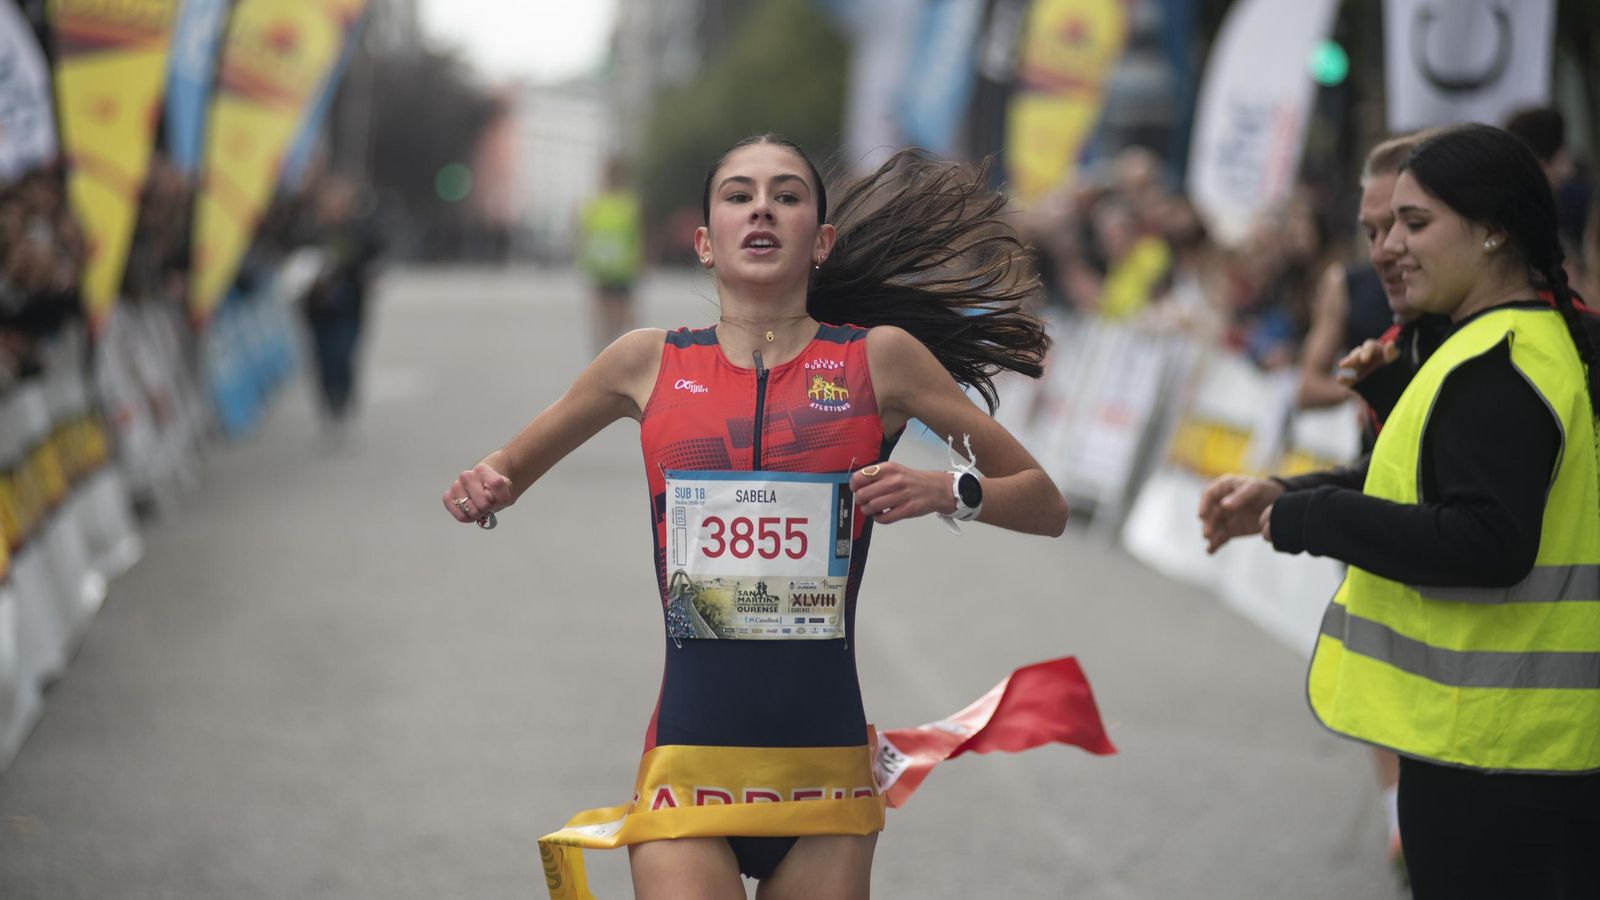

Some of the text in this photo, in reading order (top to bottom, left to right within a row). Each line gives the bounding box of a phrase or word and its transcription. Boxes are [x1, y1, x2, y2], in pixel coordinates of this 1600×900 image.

[808, 401, 851, 412] ATLETISMO
[675, 486, 705, 500] SUB 18
[735, 489, 777, 503] SABELA
[701, 516, 808, 560] 3855
[792, 593, 836, 607] XLVIII
